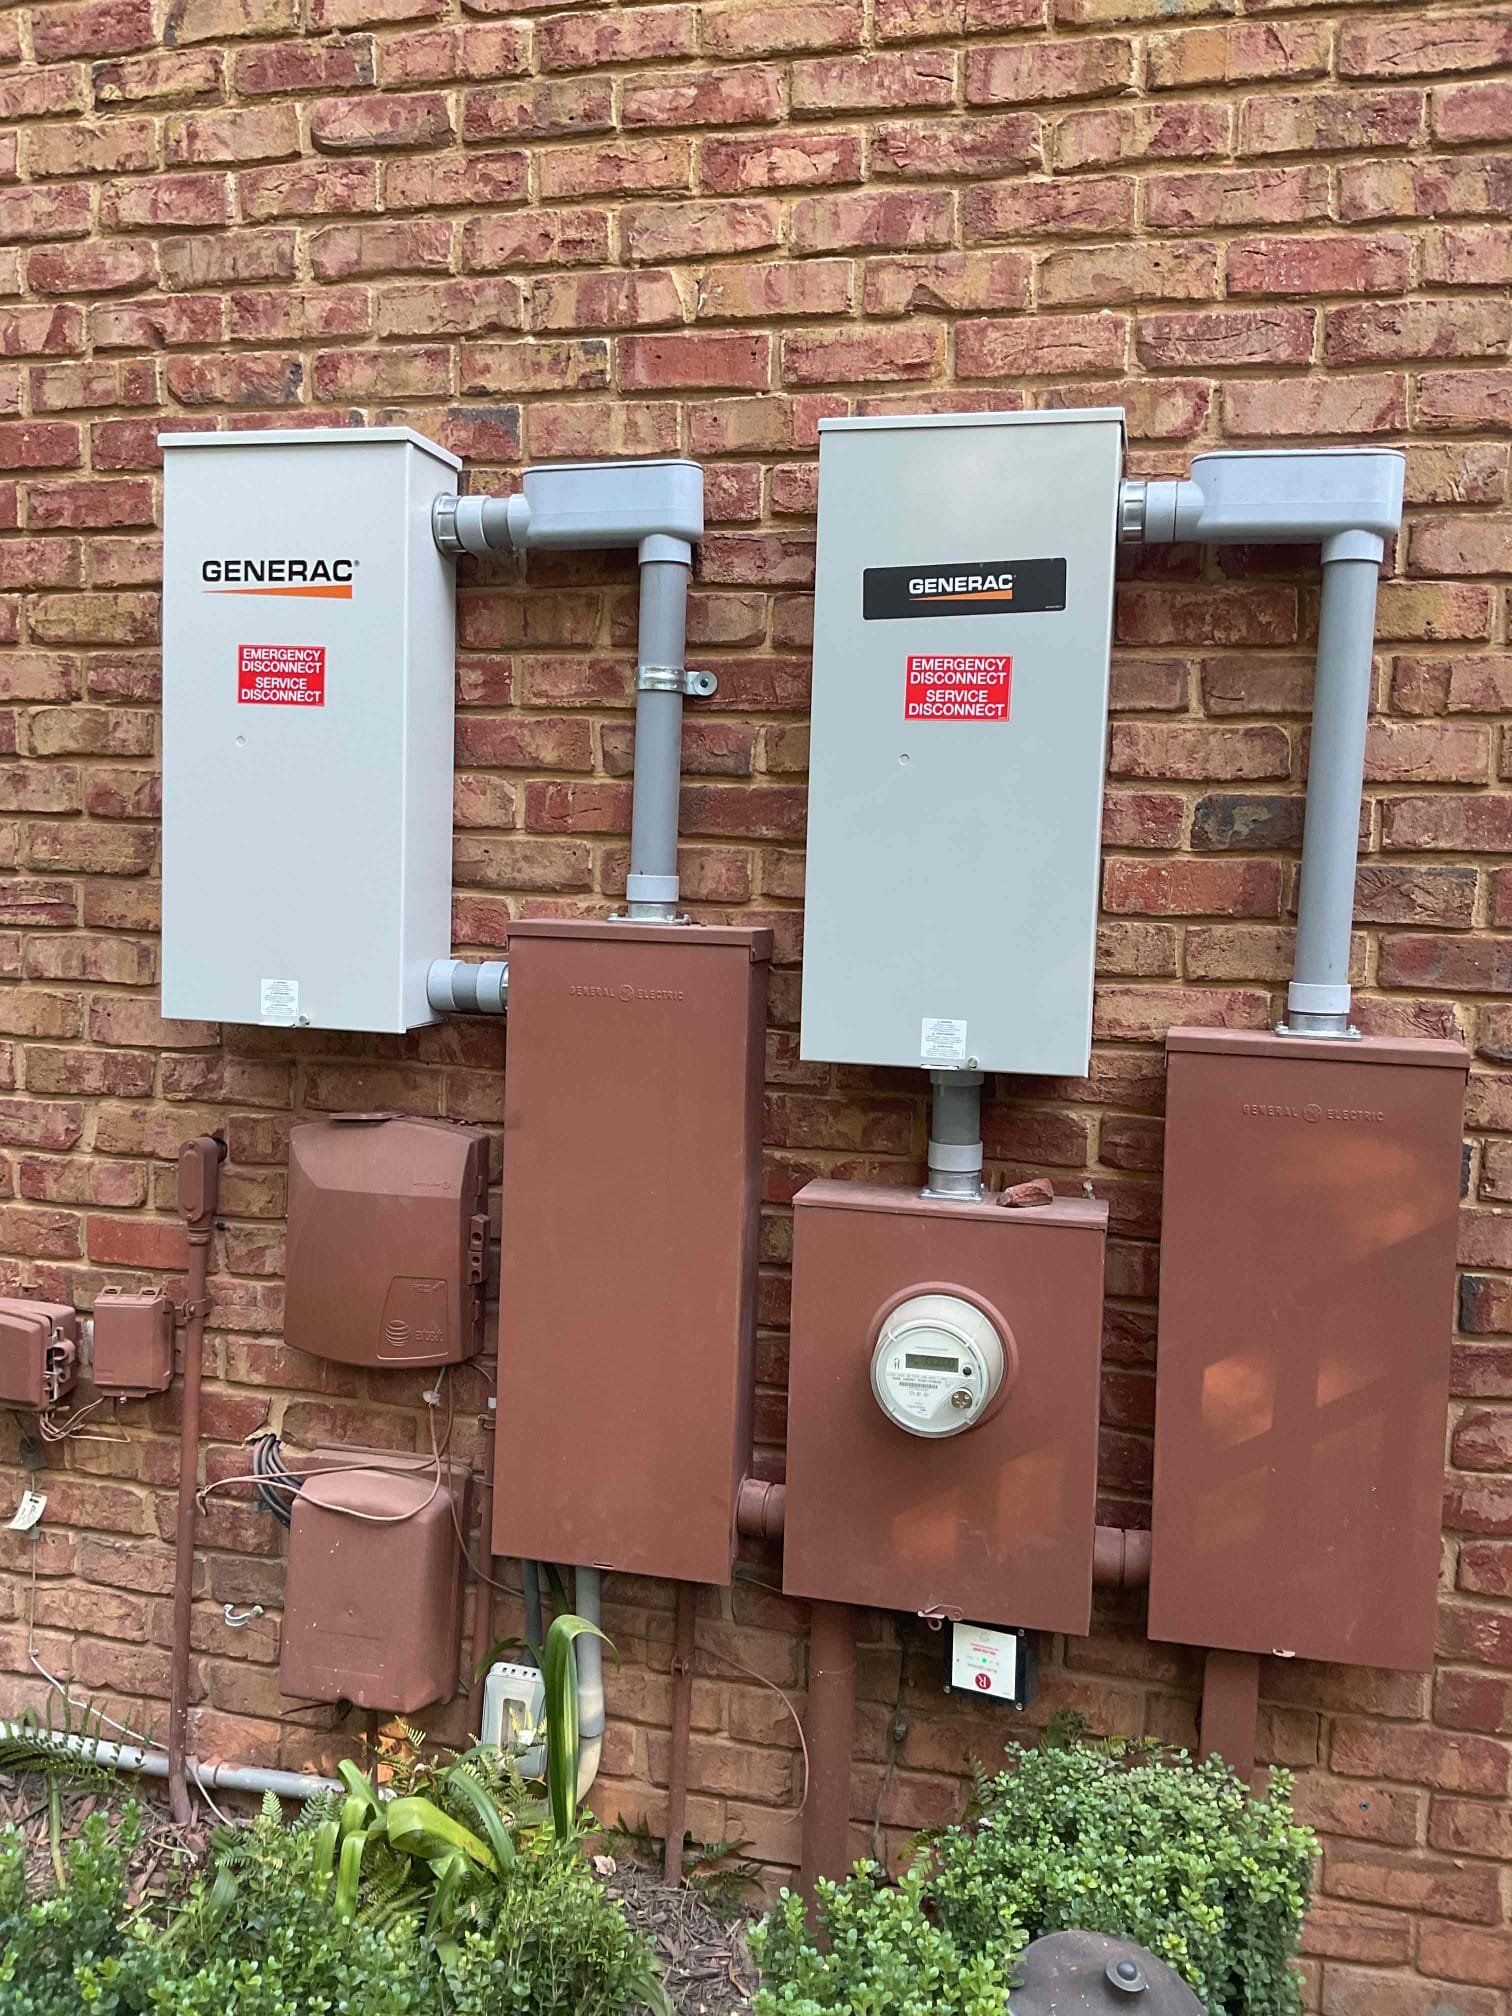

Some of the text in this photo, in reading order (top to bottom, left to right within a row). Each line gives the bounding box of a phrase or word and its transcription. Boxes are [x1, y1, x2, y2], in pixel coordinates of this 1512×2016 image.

[202, 559, 353, 582] GENERAC
[908, 574, 1013, 594] GENERAC
[242, 648, 321, 662] EMERGENCY
[241, 661, 322, 674] DISCONNECT
[911, 658, 1006, 672] EMERGENCY
[255, 676, 307, 690] SERVICE
[909, 672, 1007, 685] DISCONNECT
[241, 689, 321, 703] DISCONNECT
[925, 690, 988, 703] SERVICE
[908, 703, 1005, 717] DISCONNECT
[1242, 1103, 1385, 1123] GENERAL ELECTRIC
